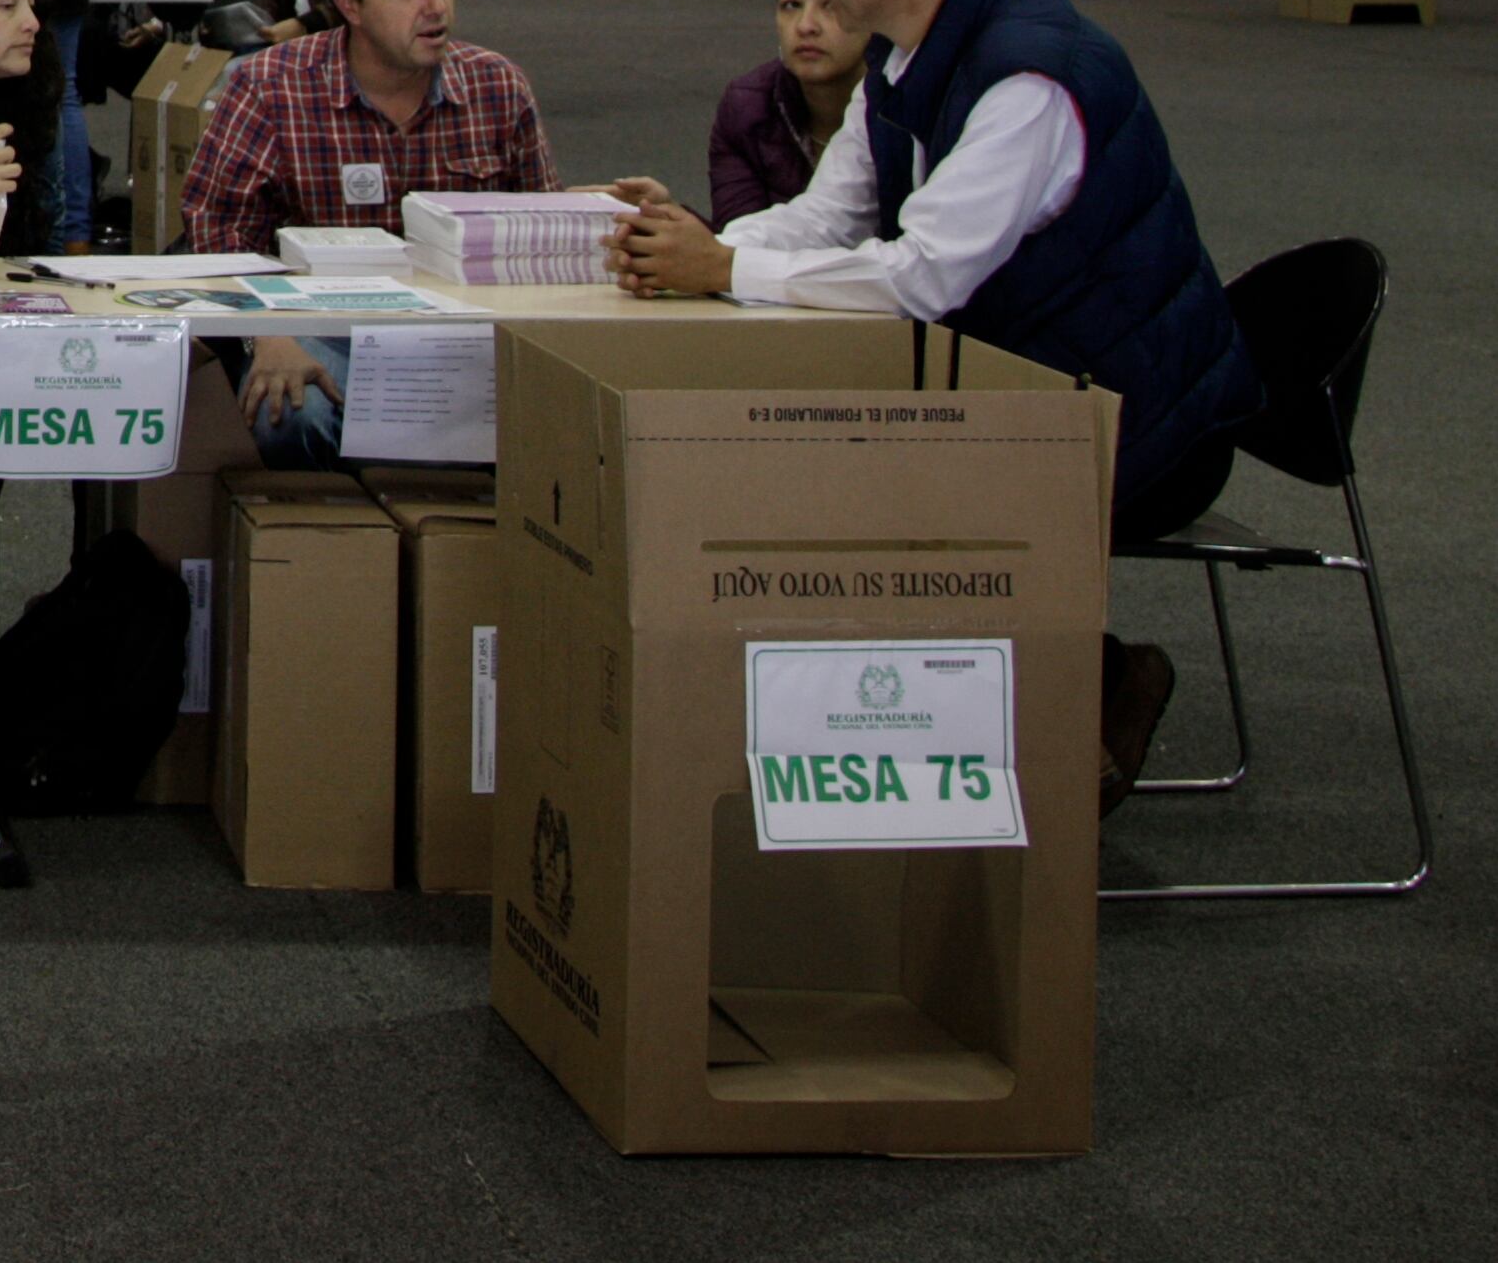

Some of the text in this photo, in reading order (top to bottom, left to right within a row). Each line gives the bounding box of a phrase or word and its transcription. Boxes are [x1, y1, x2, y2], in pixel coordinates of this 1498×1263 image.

[34, 373, 123, 385] REGISTRADURÍA
[114, 408, 165, 446] 75
[748, 407, 965, 425] PEGUE AQUÍ EL FORMULARIO E-9
[711, 566, 1013, 603] DEPOSITE SU VOTO AQUÍ
[825, 710, 934, 724] REGISTRADURÍA
[759, 753, 992, 804] MESA 75
[505, 898, 601, 1018] REGISTRADURÍA
